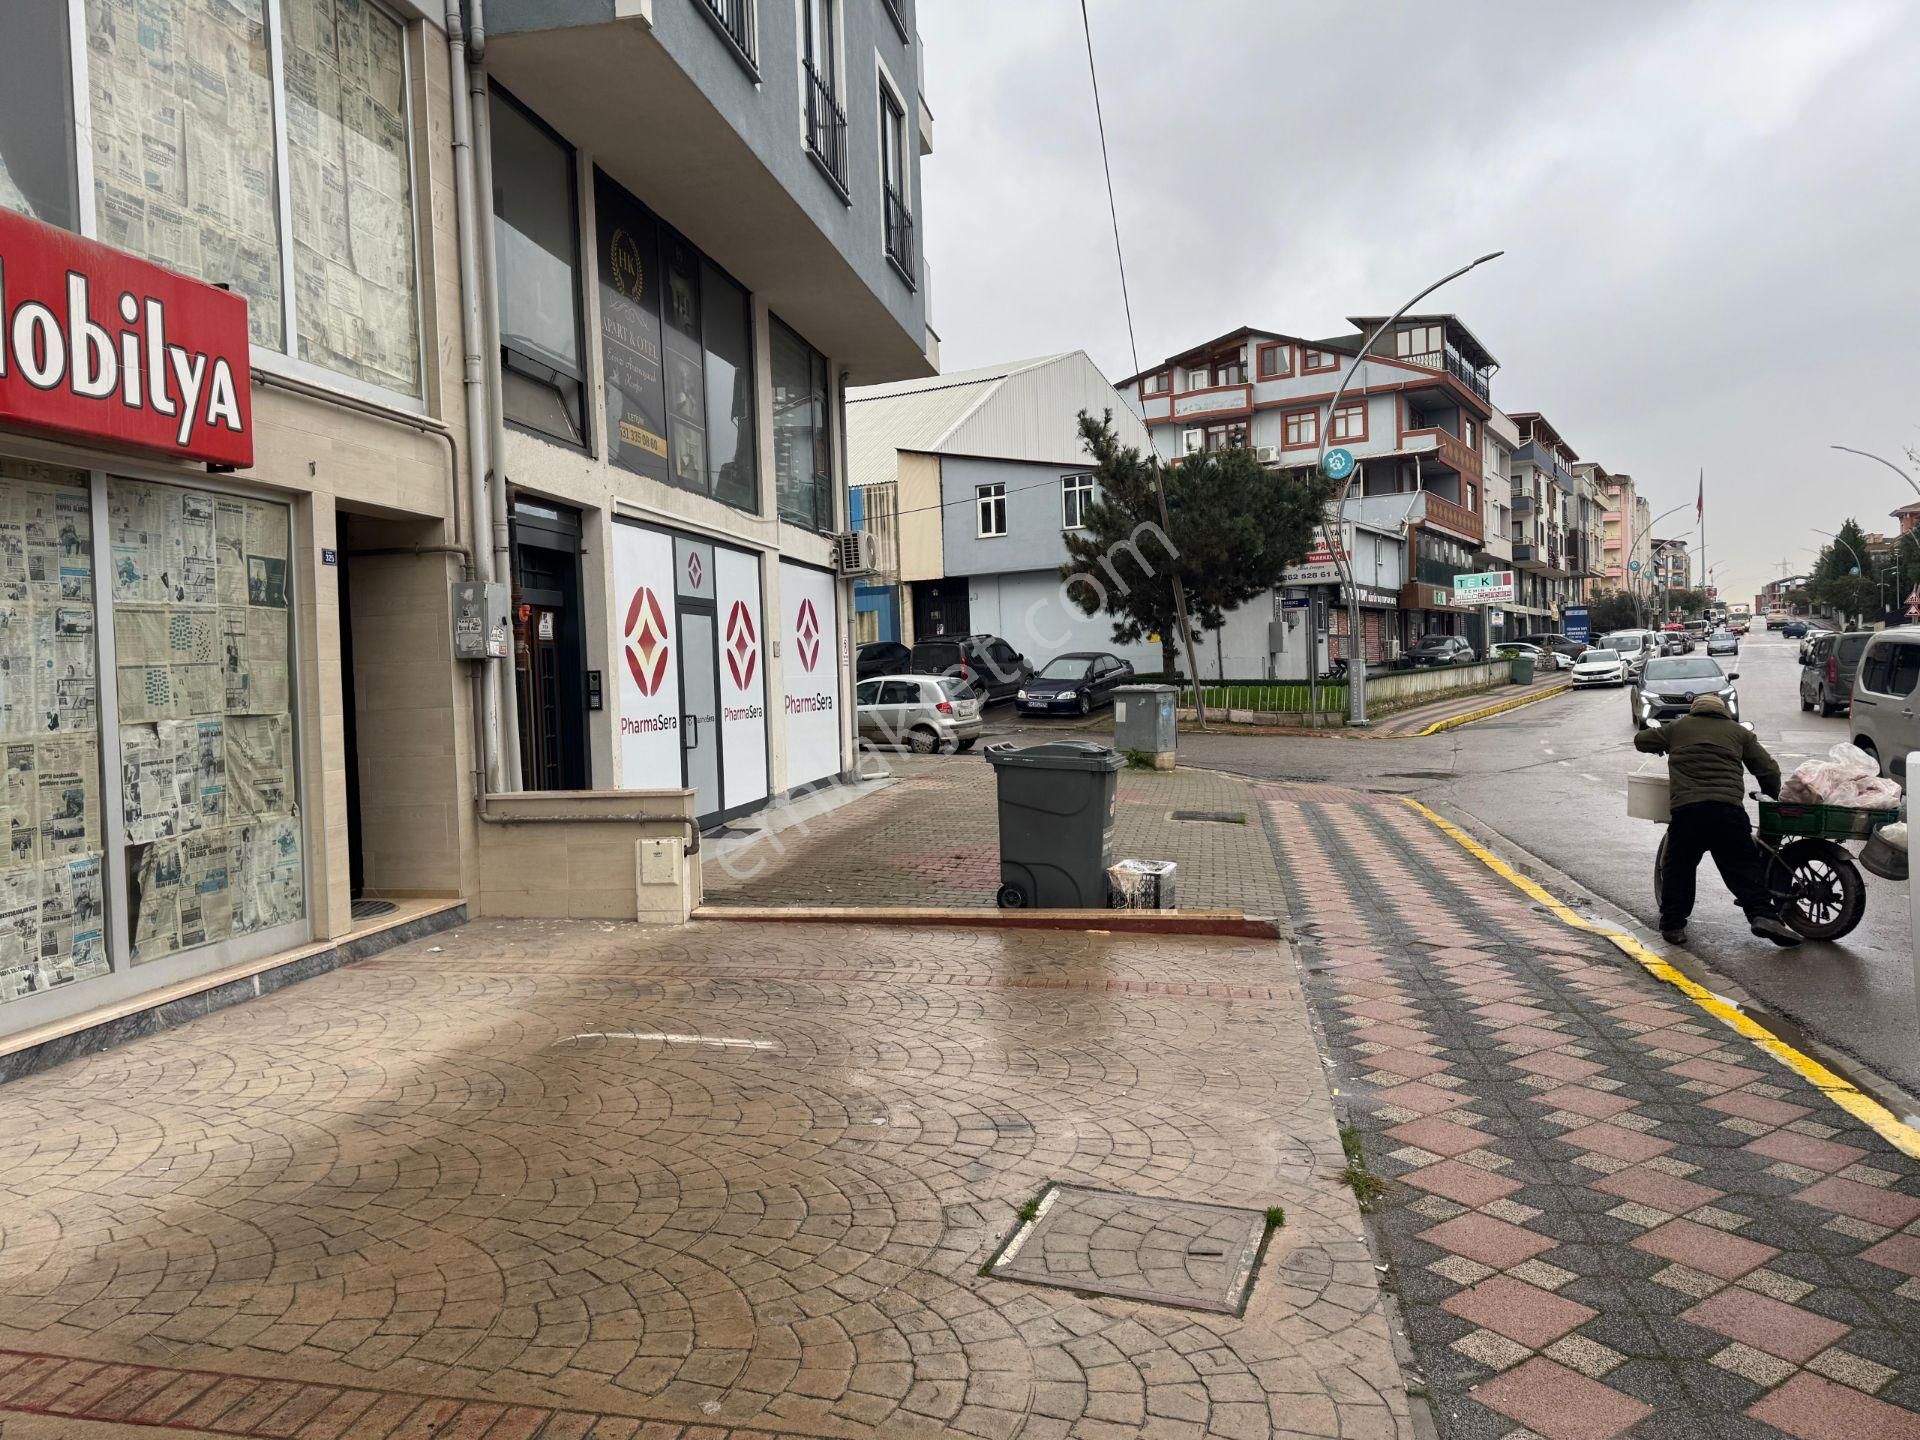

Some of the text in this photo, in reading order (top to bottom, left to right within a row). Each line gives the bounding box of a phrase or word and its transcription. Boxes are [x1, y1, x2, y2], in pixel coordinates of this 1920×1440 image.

[618, 247, 638, 277] HK
[602, 316, 627, 341] APART
[637, 335, 659, 361] OTEL
[0, 255, 243, 447] obilyA
[325, 554, 335, 562] 325
[1457, 577, 1490, 588] TEK
[724, 704, 763, 722] PharmaSera
[784, 692, 833, 715] PharmaSera
[621, 714, 677, 735] PharmaSera
